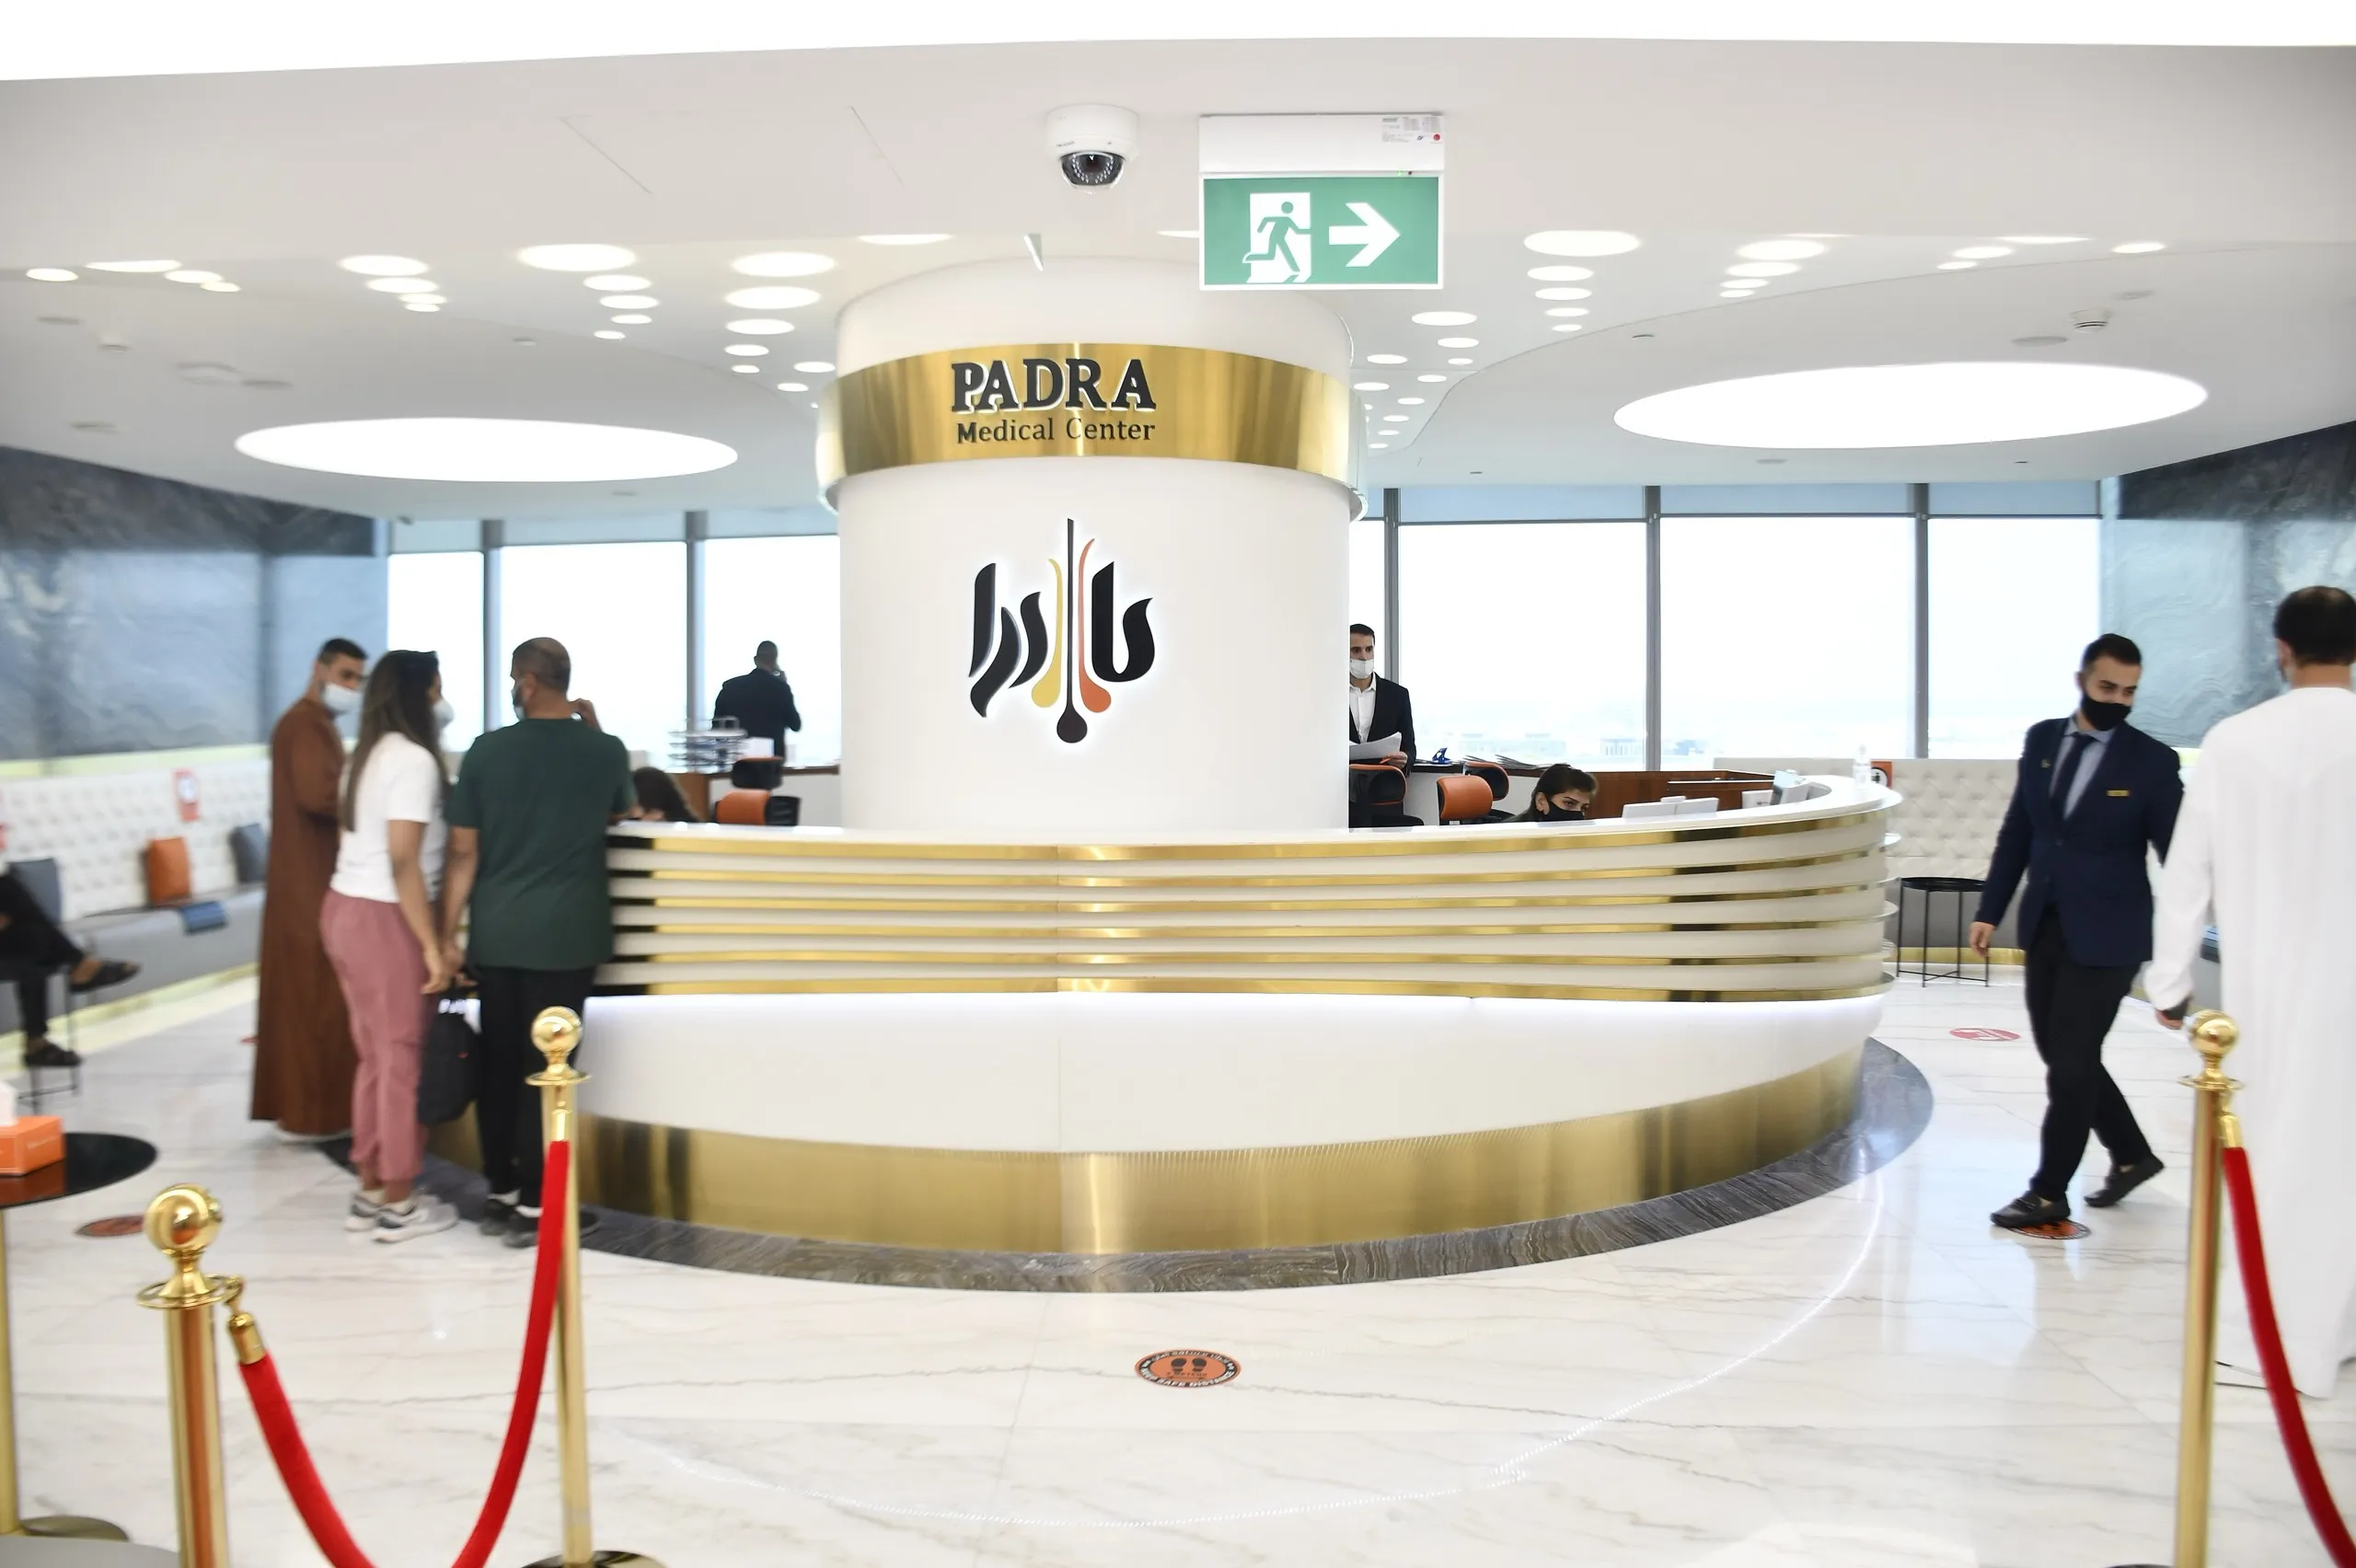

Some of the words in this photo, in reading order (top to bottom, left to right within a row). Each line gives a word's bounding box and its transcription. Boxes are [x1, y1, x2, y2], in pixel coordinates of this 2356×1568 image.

[952, 358, 1156, 411] PADRA
[957, 418, 1054, 444] Medical
[1066, 417, 1155, 440] Center
